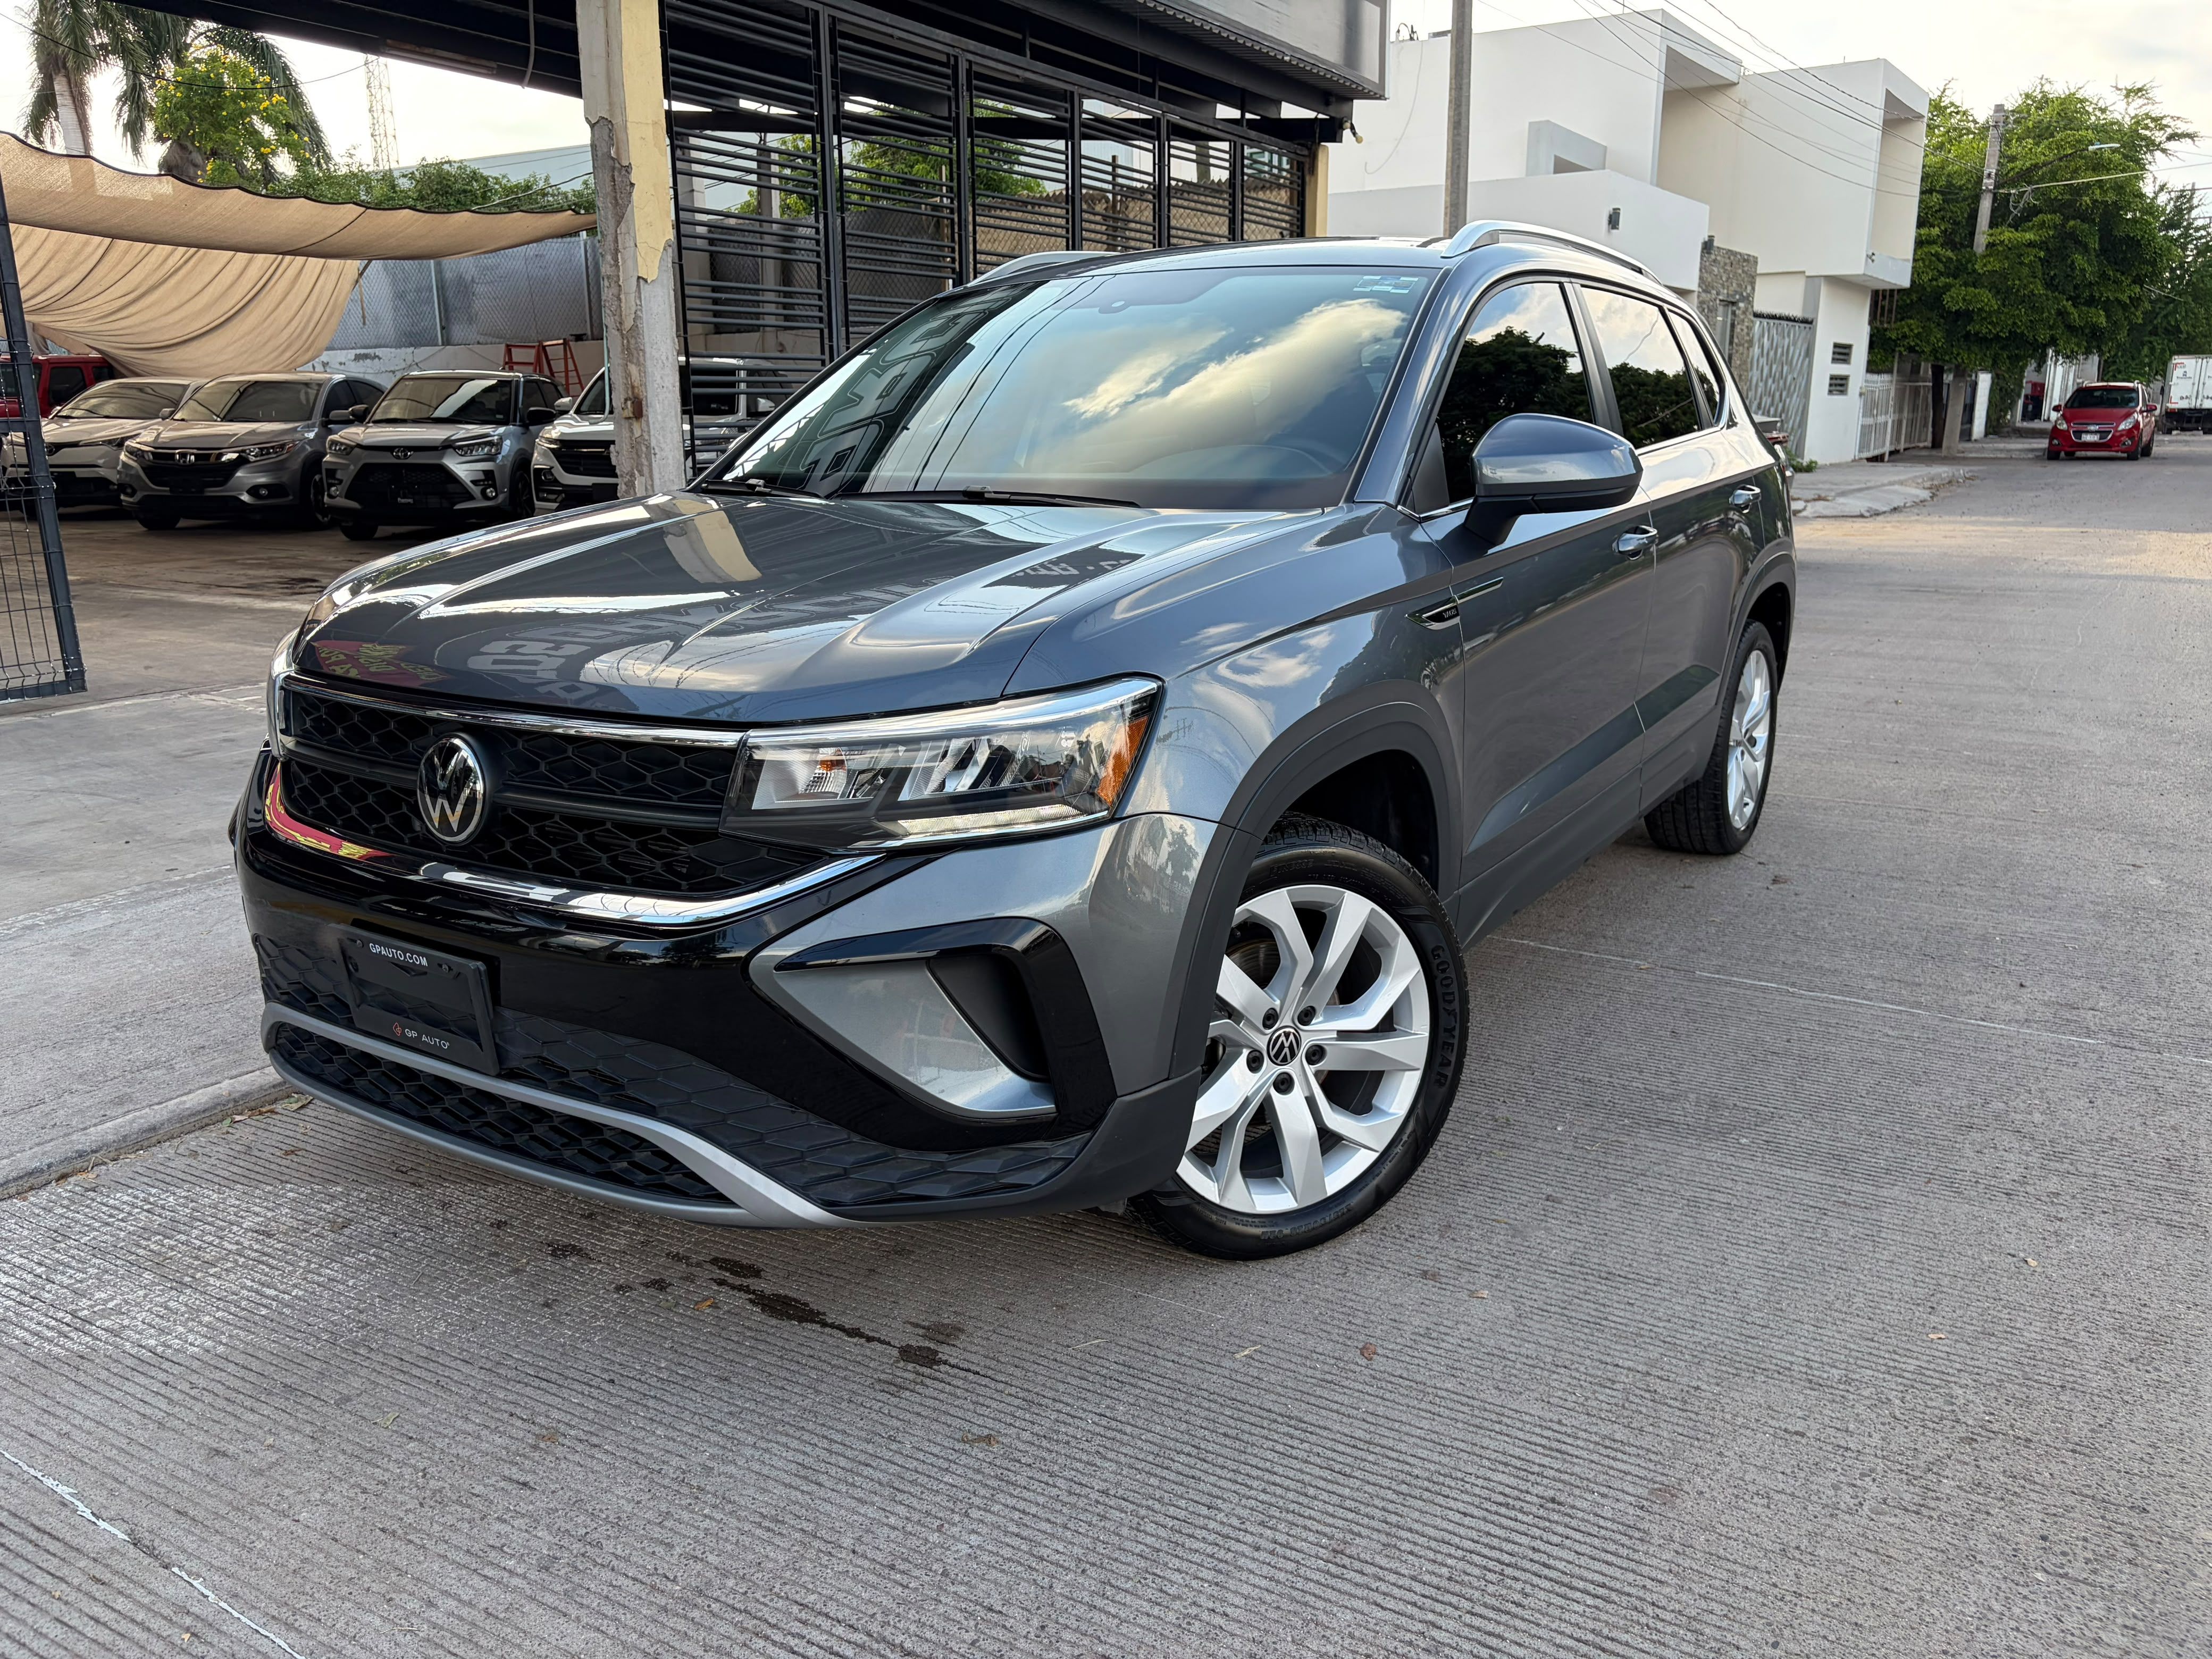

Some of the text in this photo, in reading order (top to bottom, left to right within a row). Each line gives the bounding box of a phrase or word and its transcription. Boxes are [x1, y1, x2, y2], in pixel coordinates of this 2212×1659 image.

[370, 943, 428, 967] GPAUTO.COM
[1430, 944, 1459, 1089] GOODYEAR
[405, 1028, 417, 1038] GP
